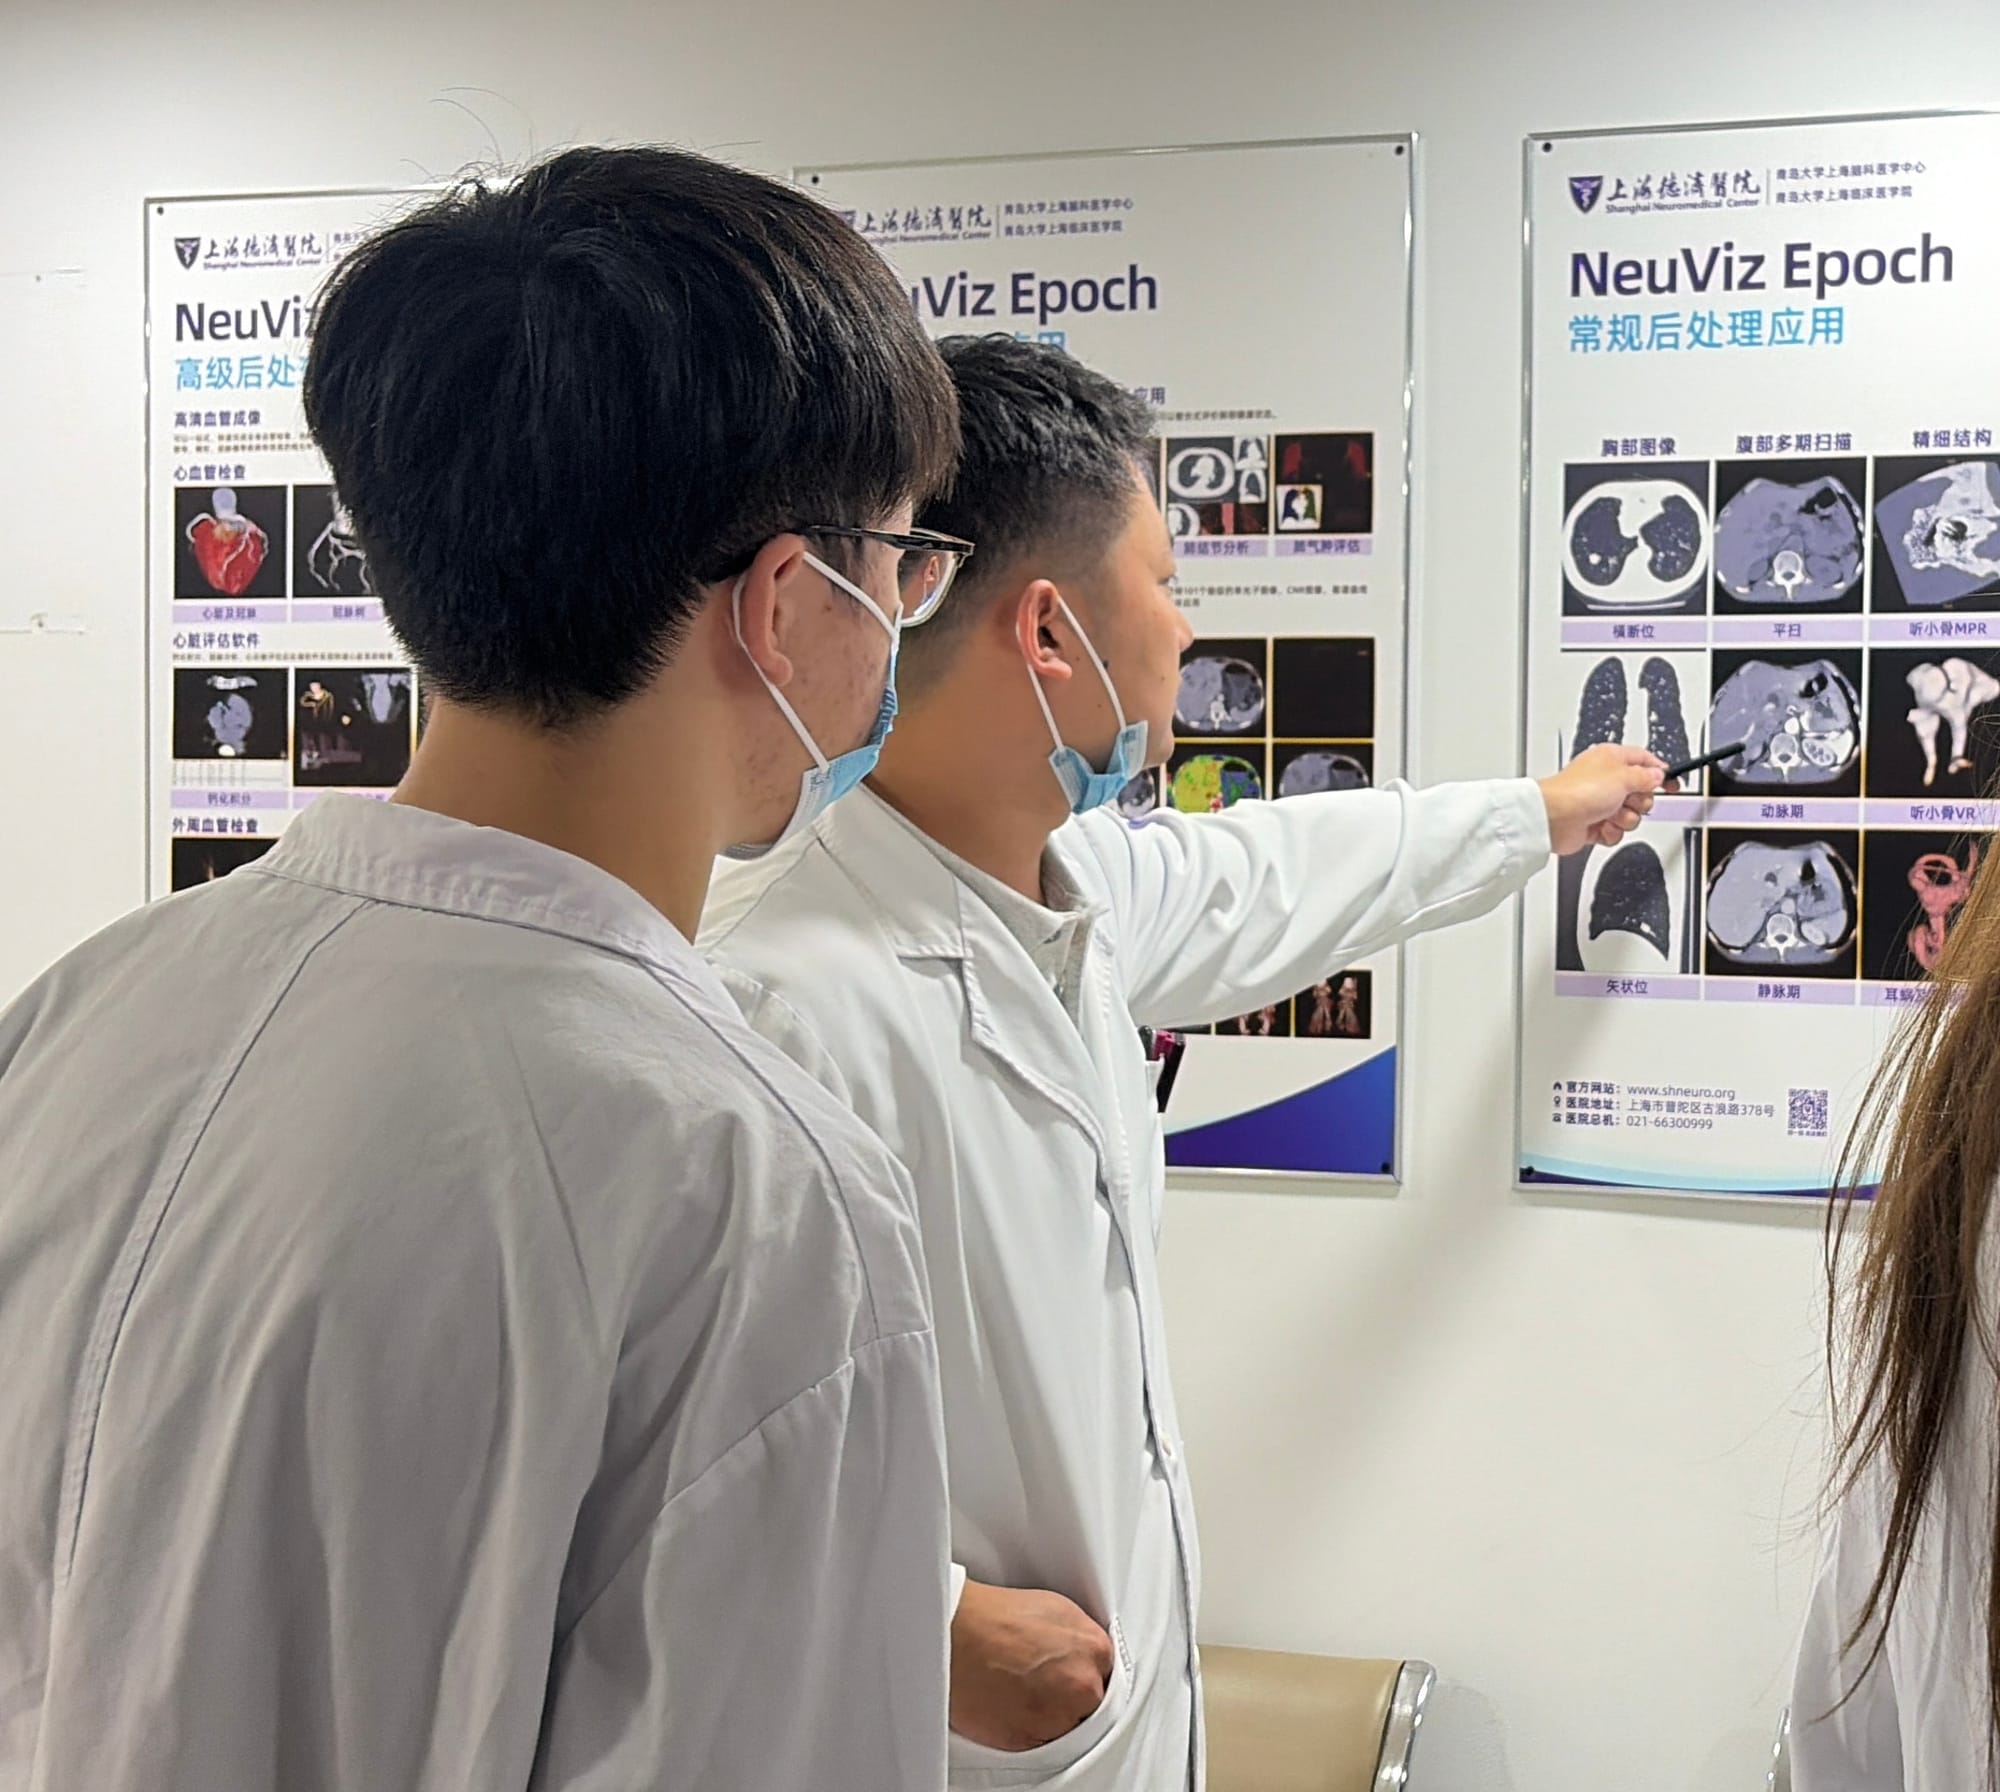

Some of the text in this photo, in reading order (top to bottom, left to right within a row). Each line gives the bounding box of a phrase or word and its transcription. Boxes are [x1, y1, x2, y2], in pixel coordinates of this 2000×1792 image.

[1605, 197, 1759, 215] Shanghai Neuromedical Center
[962, 231, 992, 240] Center
[1570, 232, 1954, 299] NeuViz Epoch
[1011, 264, 1157, 325] Epoch
[1568, 306, 1845, 354] 常规后处理应用
[174, 410, 261, 428] 高清血管成像
[1600, 437, 1677, 457] 胸部图像
[1735, 432, 1853, 453] 腹部多期扫描
[1912, 429, 1992, 450] 精细结构
[174, 465, 247, 482] 心血管检查
[1612, 622, 1655, 638] 横断位
[1773, 623, 1801, 638] 平扫
[1909, 620, 1987, 637] 听小骨MPR
[172, 632, 260, 649] 心脏评估软件
[1760, 804, 1804, 820] 动脉期
[1910, 804, 1976, 821] 听小骨VR
[172, 817, 259, 833] 外周血管检查
[1606, 979, 1648, 995] 矢状位
[1757, 982, 1801, 999] 静脉期
[1627, 1085, 1735, 1101] www.shneuro.org
[1627, 1100, 1775, 1118] 上海市普陀区古浪路378号
[1626, 1117, 1713, 1130] 021-66300999
